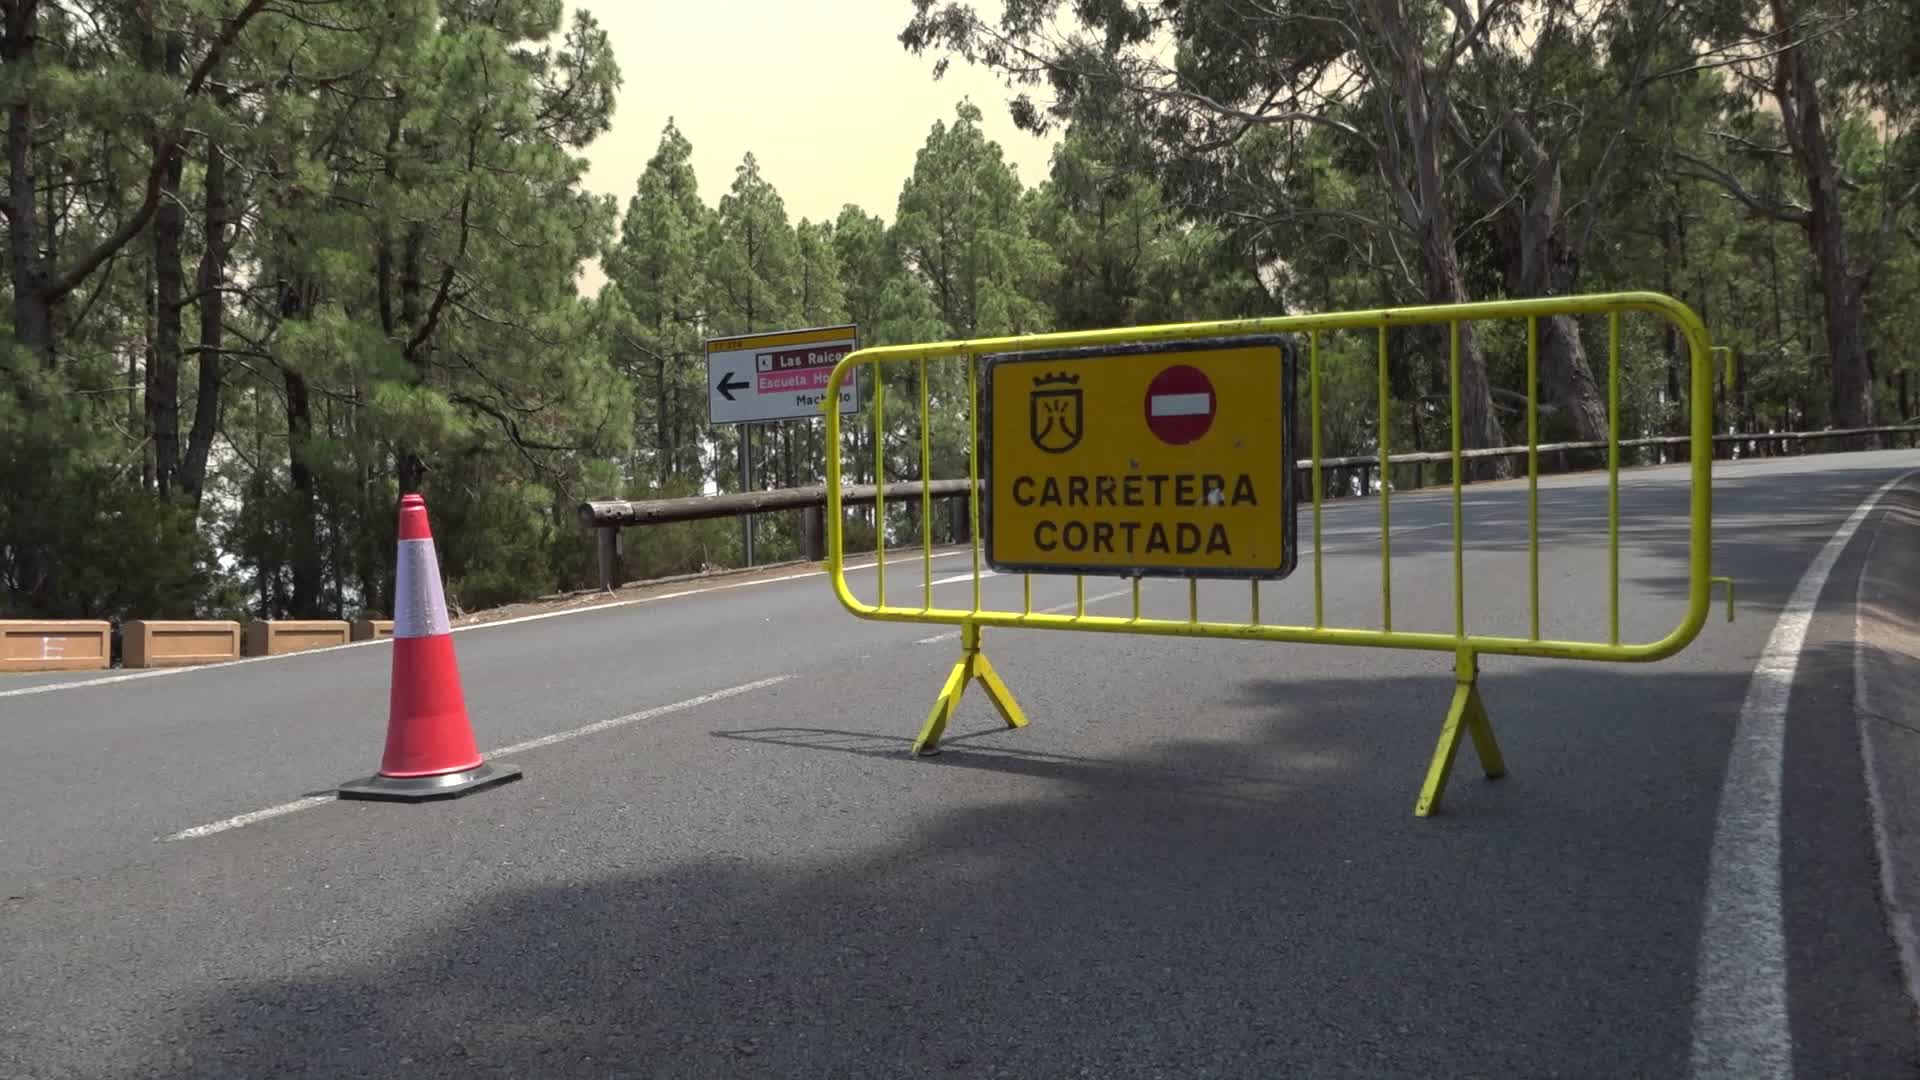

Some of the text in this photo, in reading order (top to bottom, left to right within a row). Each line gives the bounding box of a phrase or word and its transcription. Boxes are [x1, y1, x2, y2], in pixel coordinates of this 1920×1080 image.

[780, 355, 802, 368] Las
[759, 375, 807, 390] Escuela
[1012, 474, 1259, 507] CARRETERA
[1034, 520, 1232, 555] CORTADA
